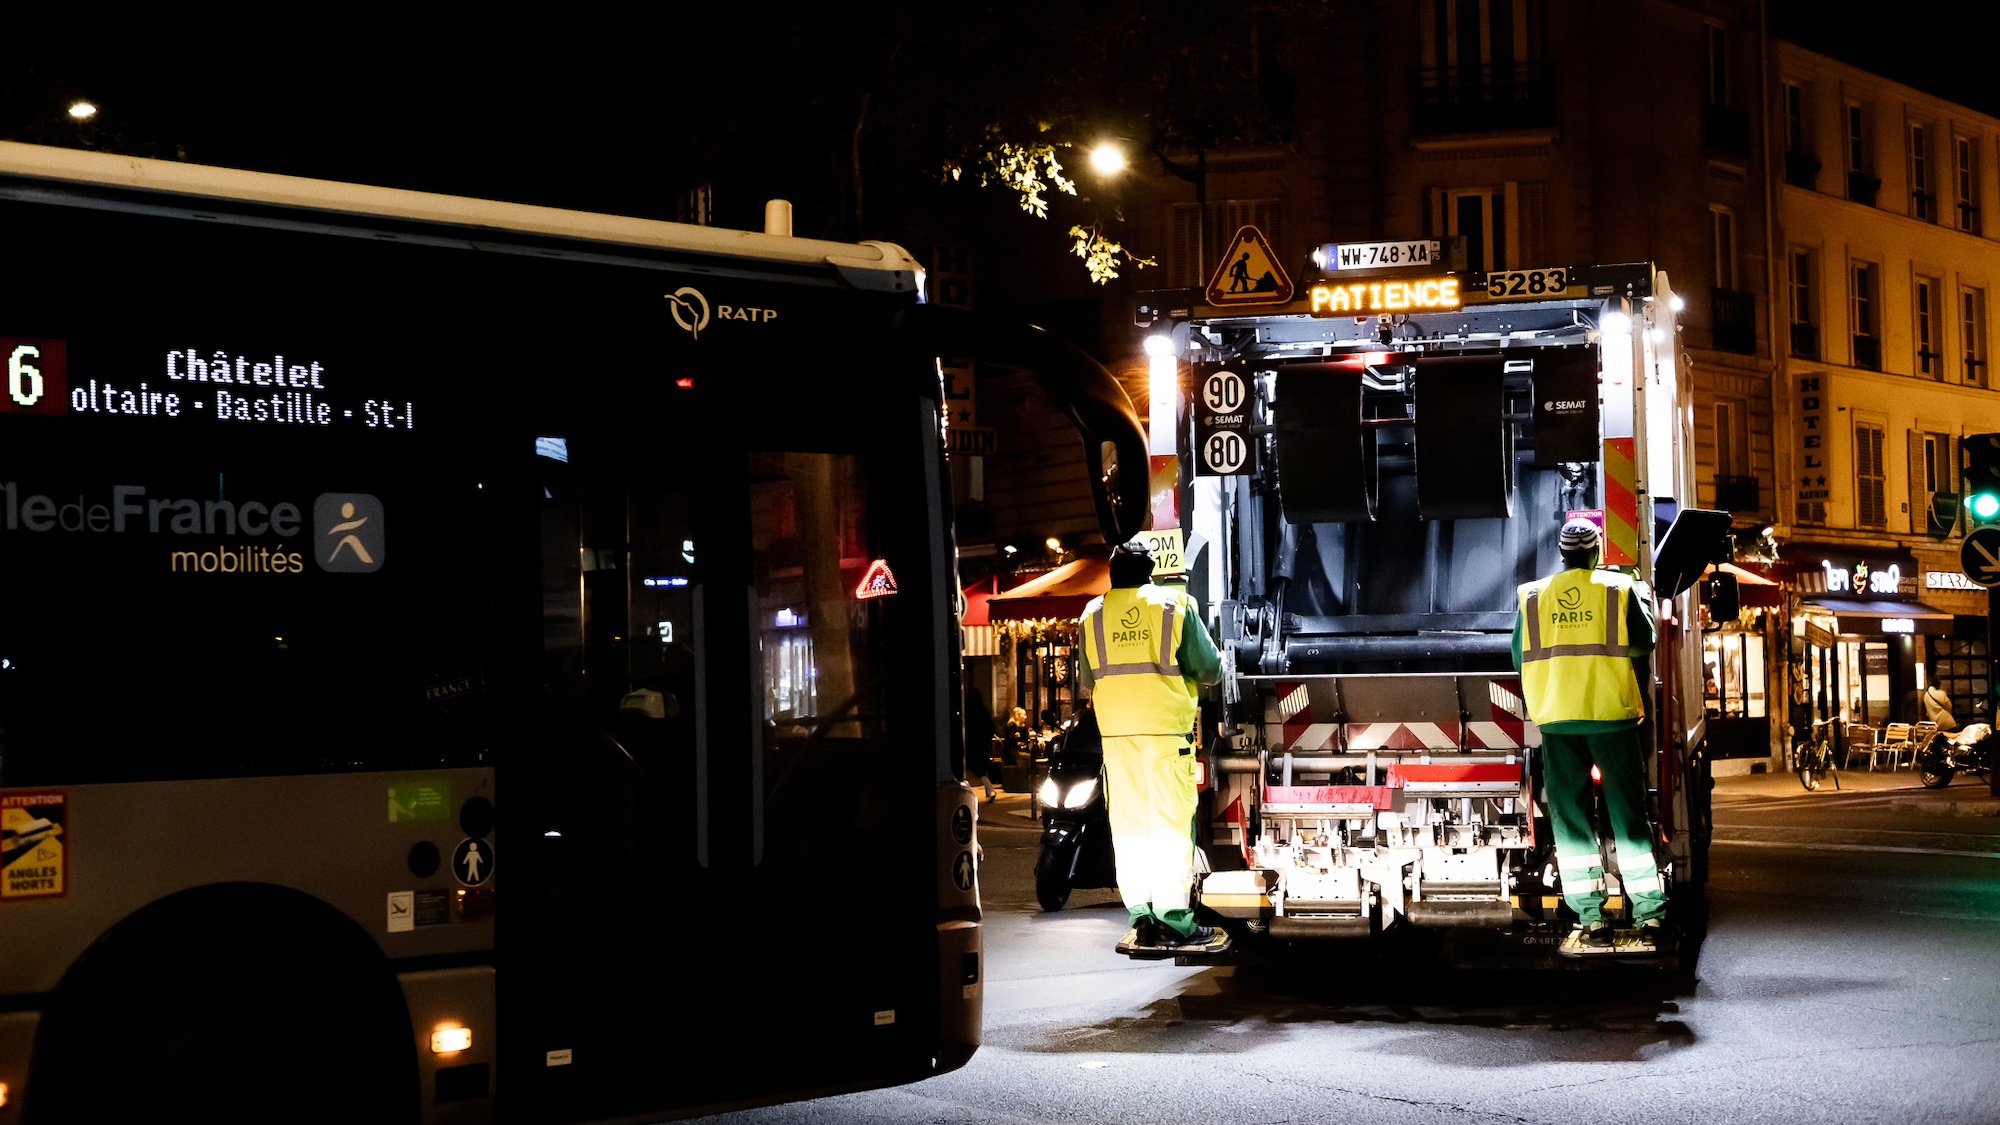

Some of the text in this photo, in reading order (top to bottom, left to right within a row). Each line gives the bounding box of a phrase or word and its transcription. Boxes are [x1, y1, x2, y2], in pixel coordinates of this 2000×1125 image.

[1341, 244, 1427, 266] WW-748-XA
[1489, 270, 1566, 297] 5283
[1311, 280, 1460, 312] PATIENCE
[718, 305, 778, 323] RATP
[8, 345, 44, 406] 6
[166, 348, 325, 389] Châtelet
[71, 379, 181, 417] oltaire
[216, 390, 332, 424] Bastille
[1210, 376, 1239, 408] 90
[1556, 400, 1587, 409] SEMAT
[1215, 415, 1244, 424] SEMAT
[1800, 377, 1822, 468] HOTEL
[1211, 436, 1240, 468] 80
[171, 544, 303, 573] mobilités
[1552, 611, 1593, 624] PARIS
[1112, 630, 1149, 642] PARIS
[426, 679, 472, 700] FRANCE
[8, 867, 57, 878] ANGLES
[10, 879, 55, 890] MORTS
